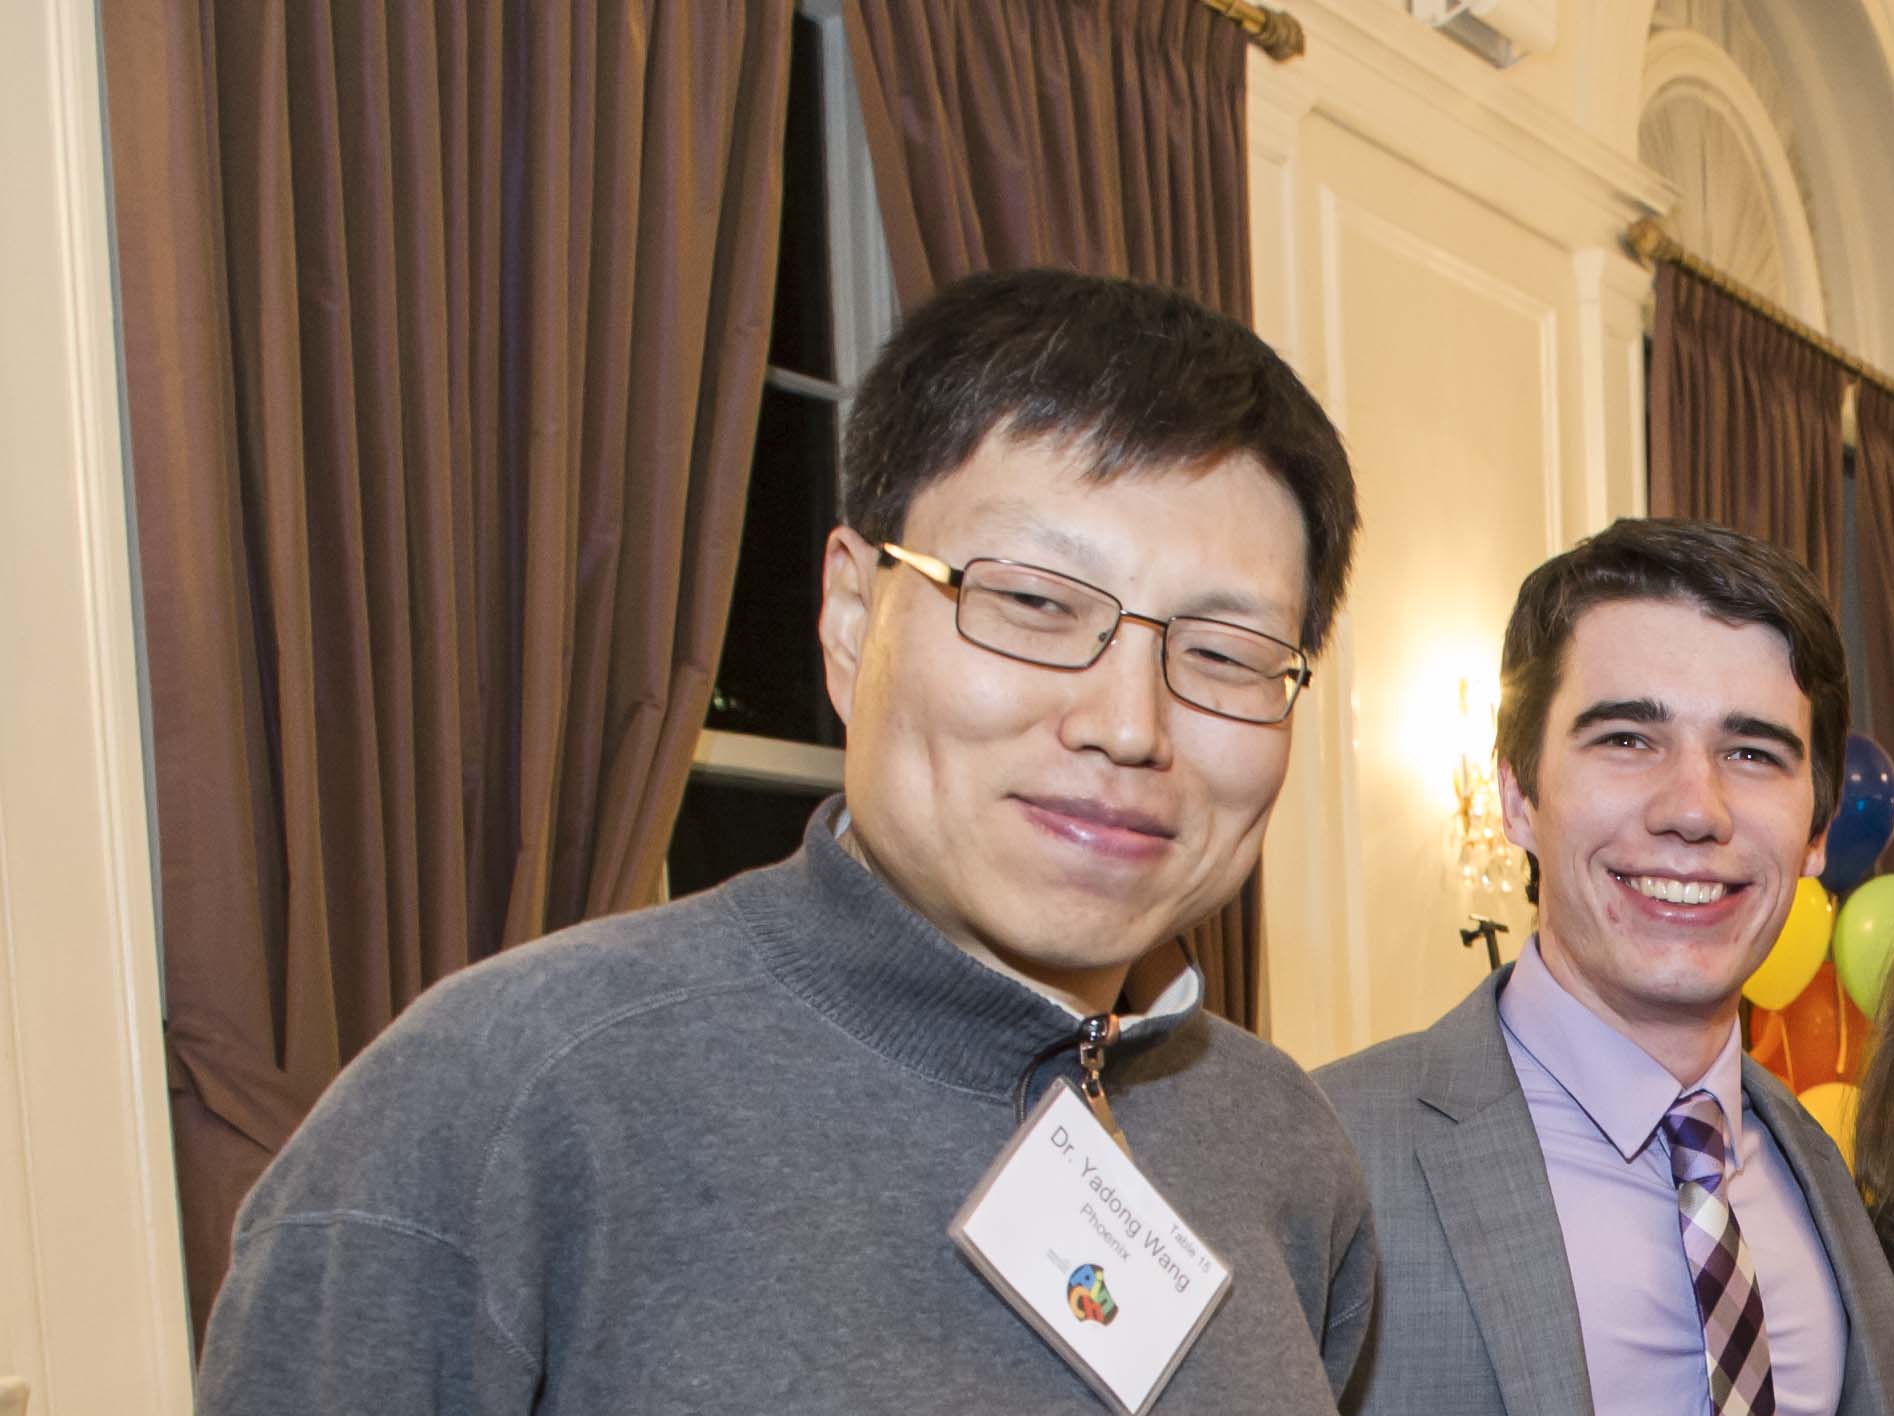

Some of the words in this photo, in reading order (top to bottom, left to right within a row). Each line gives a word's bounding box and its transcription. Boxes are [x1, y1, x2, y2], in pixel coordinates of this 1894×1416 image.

[1050, 1125, 1075, 1164] Dr.
[1079, 1157, 1141, 1236] Yadong
[1145, 1230, 1191, 1294] Wang
[1079, 1202, 1131, 1263] Phoenix
[1170, 1223, 1197, 1259] Table
